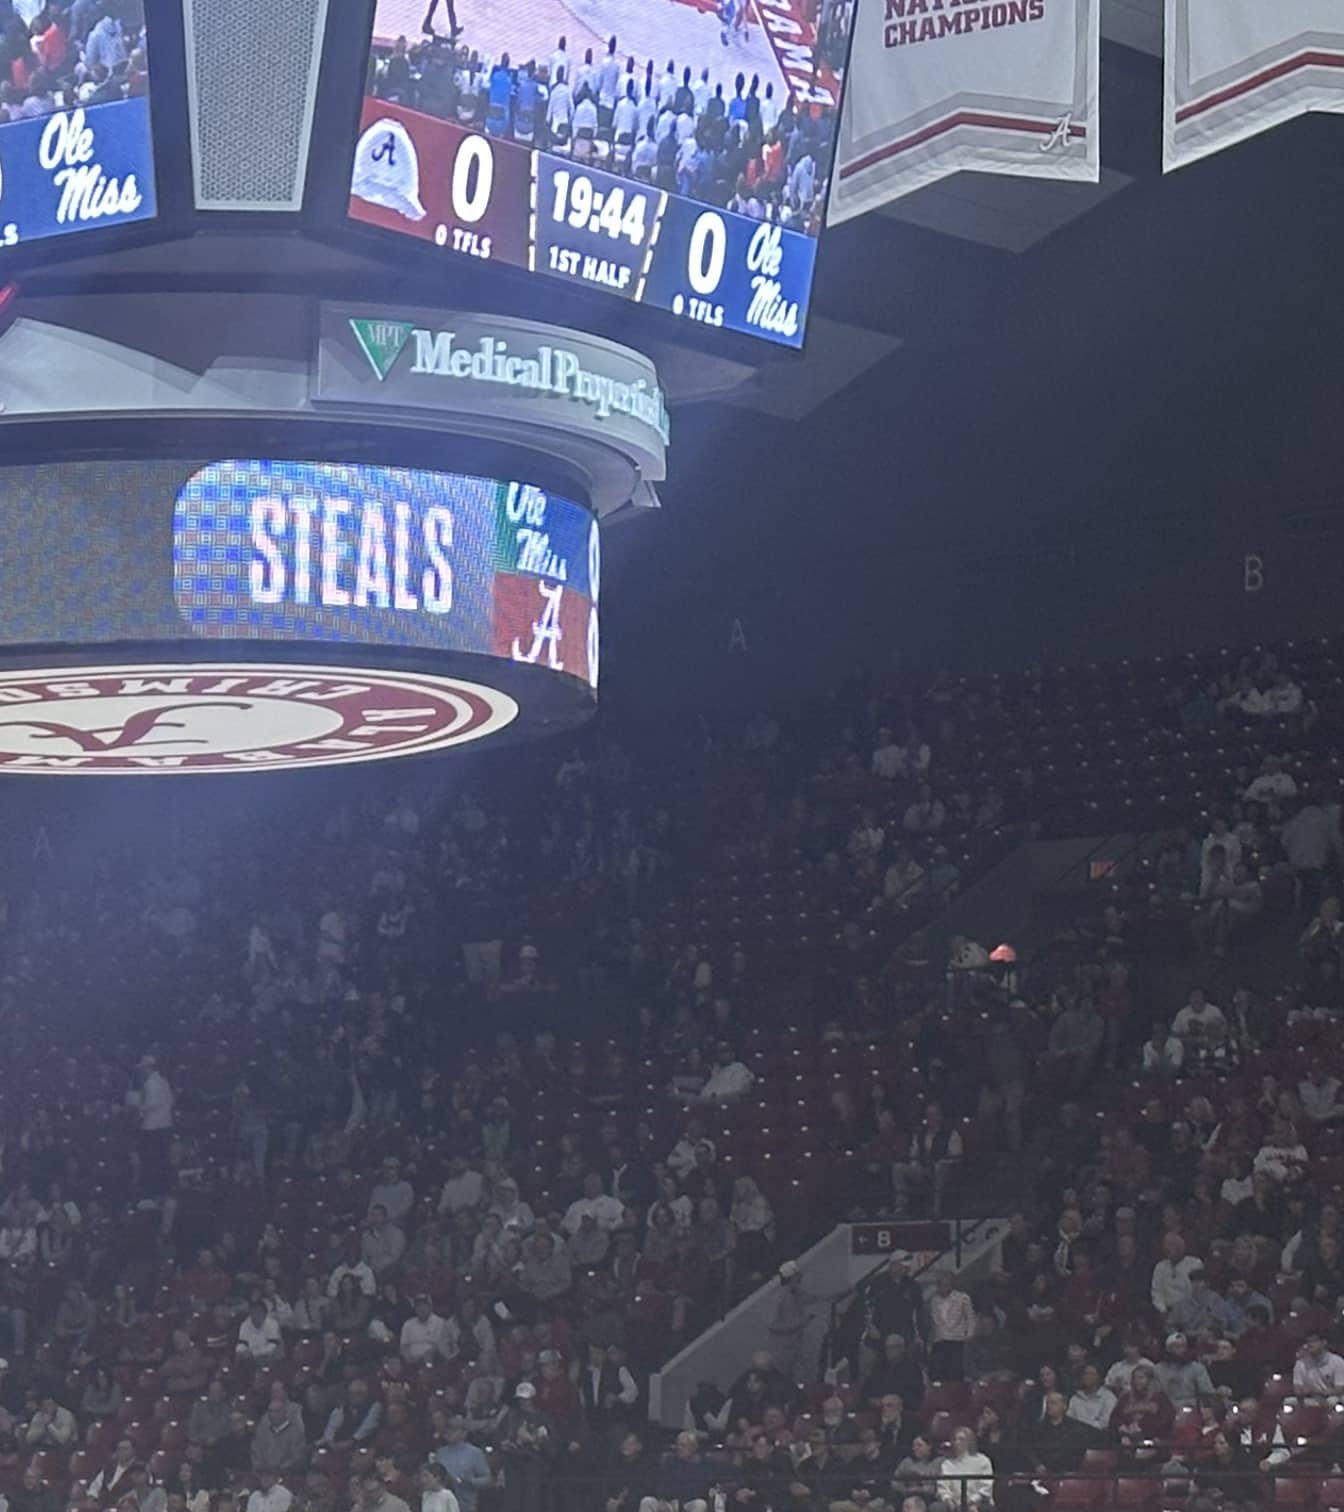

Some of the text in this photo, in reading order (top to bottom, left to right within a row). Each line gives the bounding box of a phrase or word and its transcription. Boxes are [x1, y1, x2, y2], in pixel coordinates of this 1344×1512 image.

[884, 3, 1044, 48] CHAMPIONS
[39, 111, 94, 170] Ole
[54, 168, 141, 224] Miss
[452, 134, 493, 224] 0
[552, 170, 647, 246] 19:44
[436, 228, 492, 260] 0 TFLS
[548, 246, 630, 289] 1ST HALF
[687, 211, 726, 295] 0
[746, 223, 783, 276] Ole
[673, 294, 724, 328] 0 TFLS
[750, 275, 798, 336] Miss
[411, 330, 552, 390] Medical
[250, 496, 453, 614] STEALS
[1243, 555, 1263, 592] B
[513, 579, 563, 670] A
